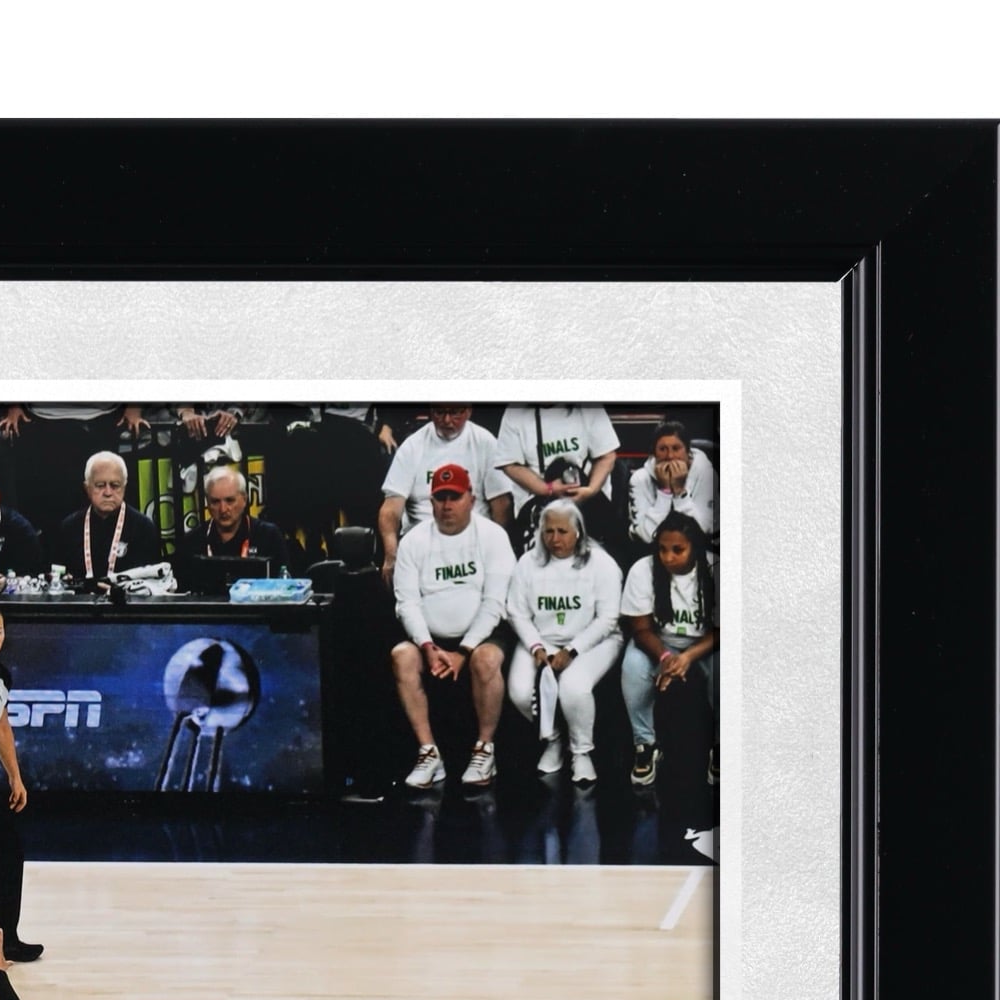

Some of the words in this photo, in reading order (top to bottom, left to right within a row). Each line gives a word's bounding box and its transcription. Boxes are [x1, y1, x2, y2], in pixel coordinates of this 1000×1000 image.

[542, 437, 580, 458] INALS
[435, 561, 477, 581] FINALS
[537, 596, 582, 611] FINALS
[674, 610, 700, 624] NALS
[7, 690, 102, 727] SPN
